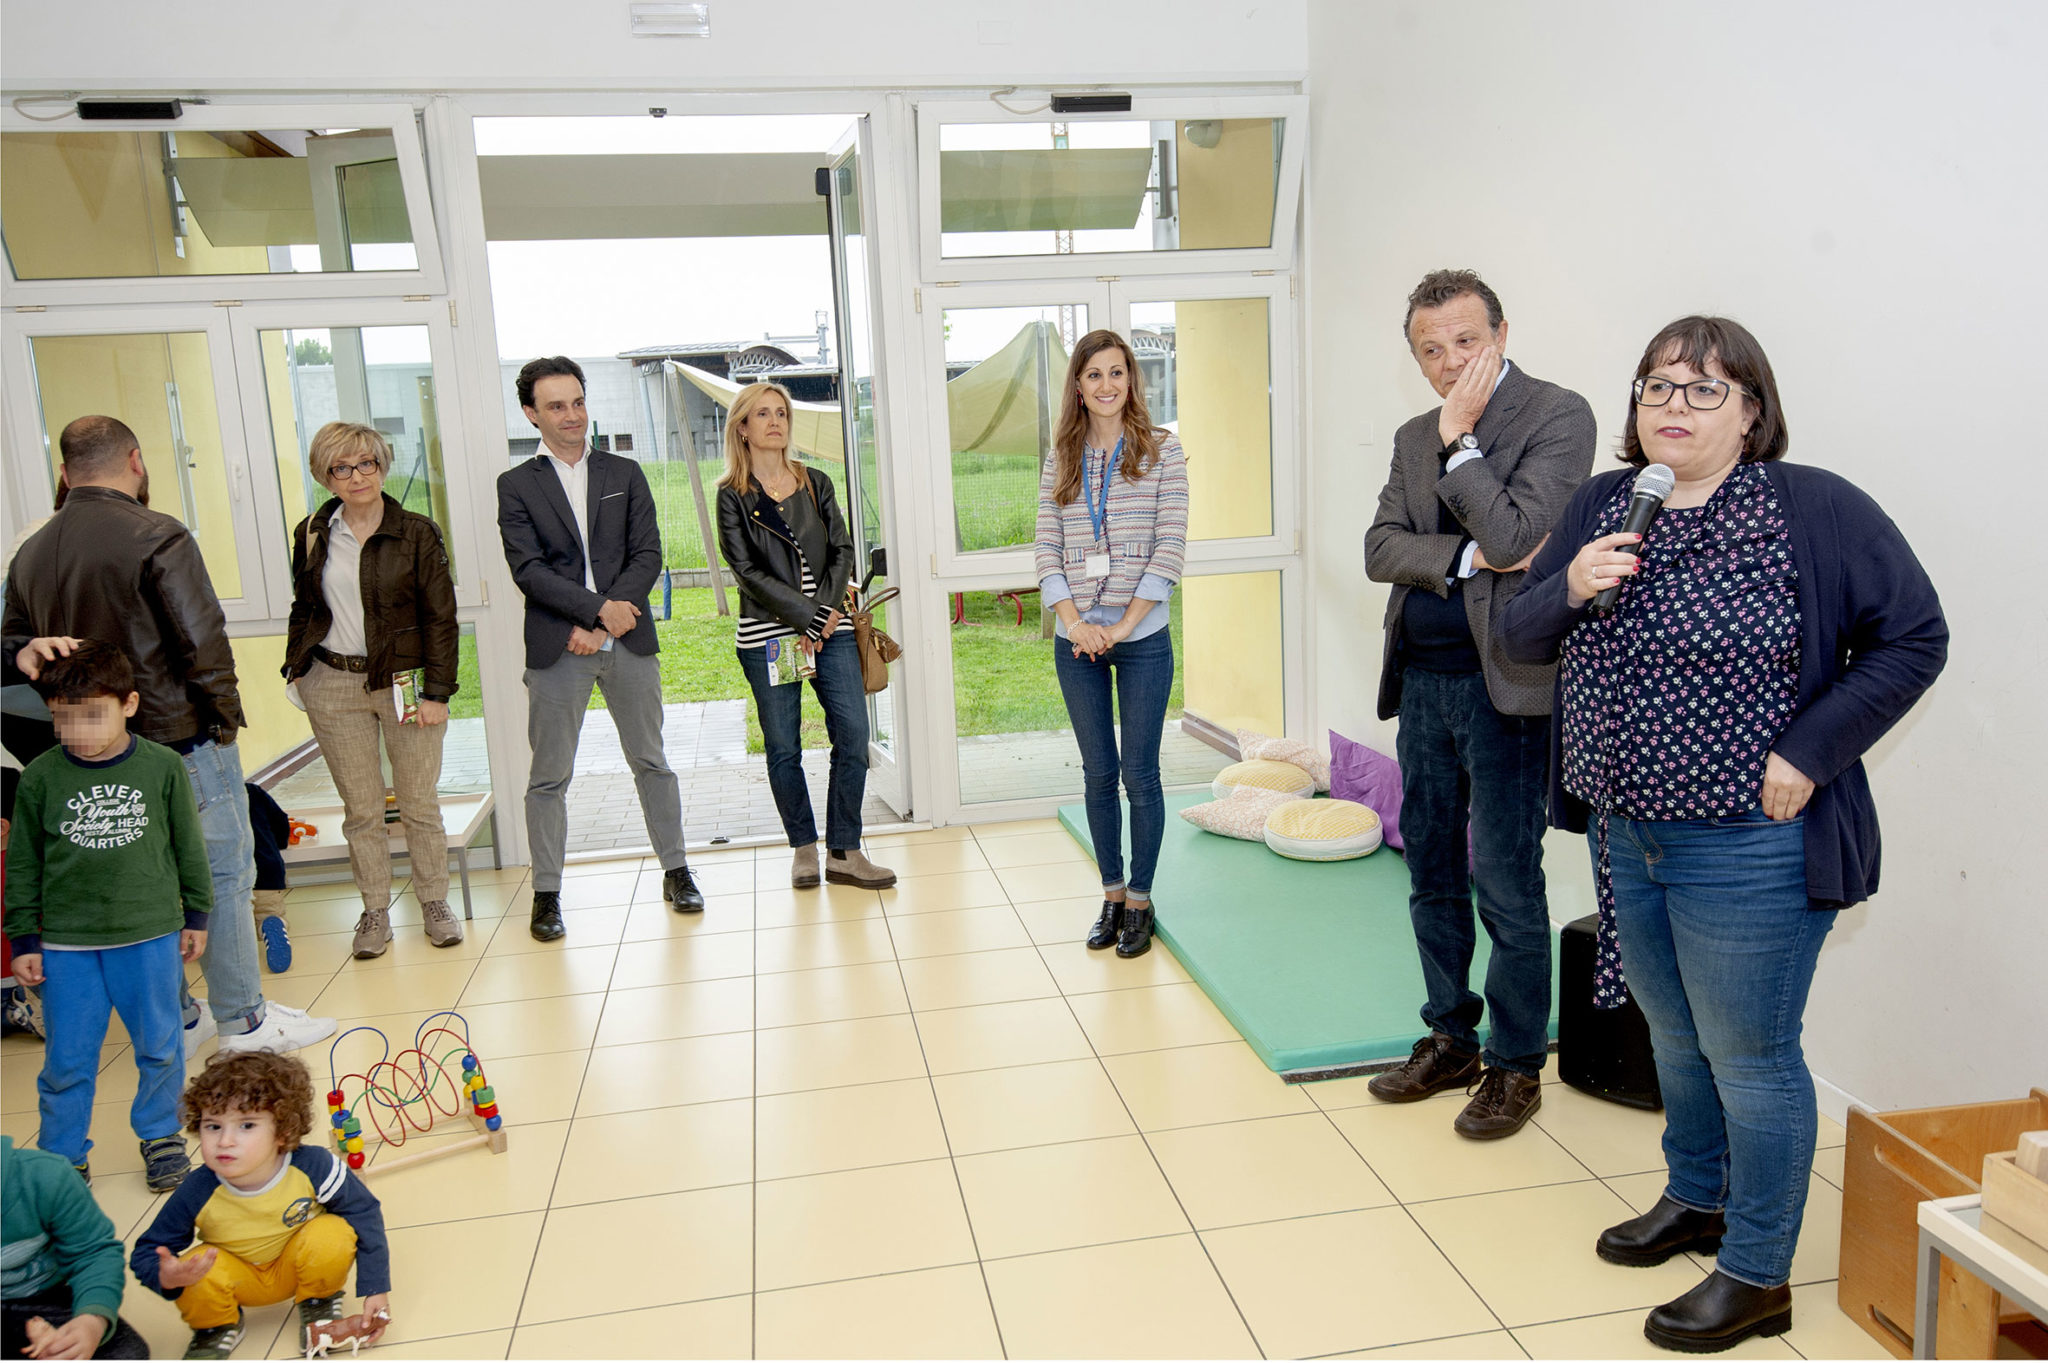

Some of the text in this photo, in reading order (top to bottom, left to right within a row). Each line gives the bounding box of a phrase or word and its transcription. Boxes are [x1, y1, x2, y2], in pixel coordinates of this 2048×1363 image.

[67, 784, 143, 810] CLEVER
[77, 802, 132, 824] Youth
[60, 817, 149, 836] Society HEAD
[70, 828, 143, 849] QUARTERS
